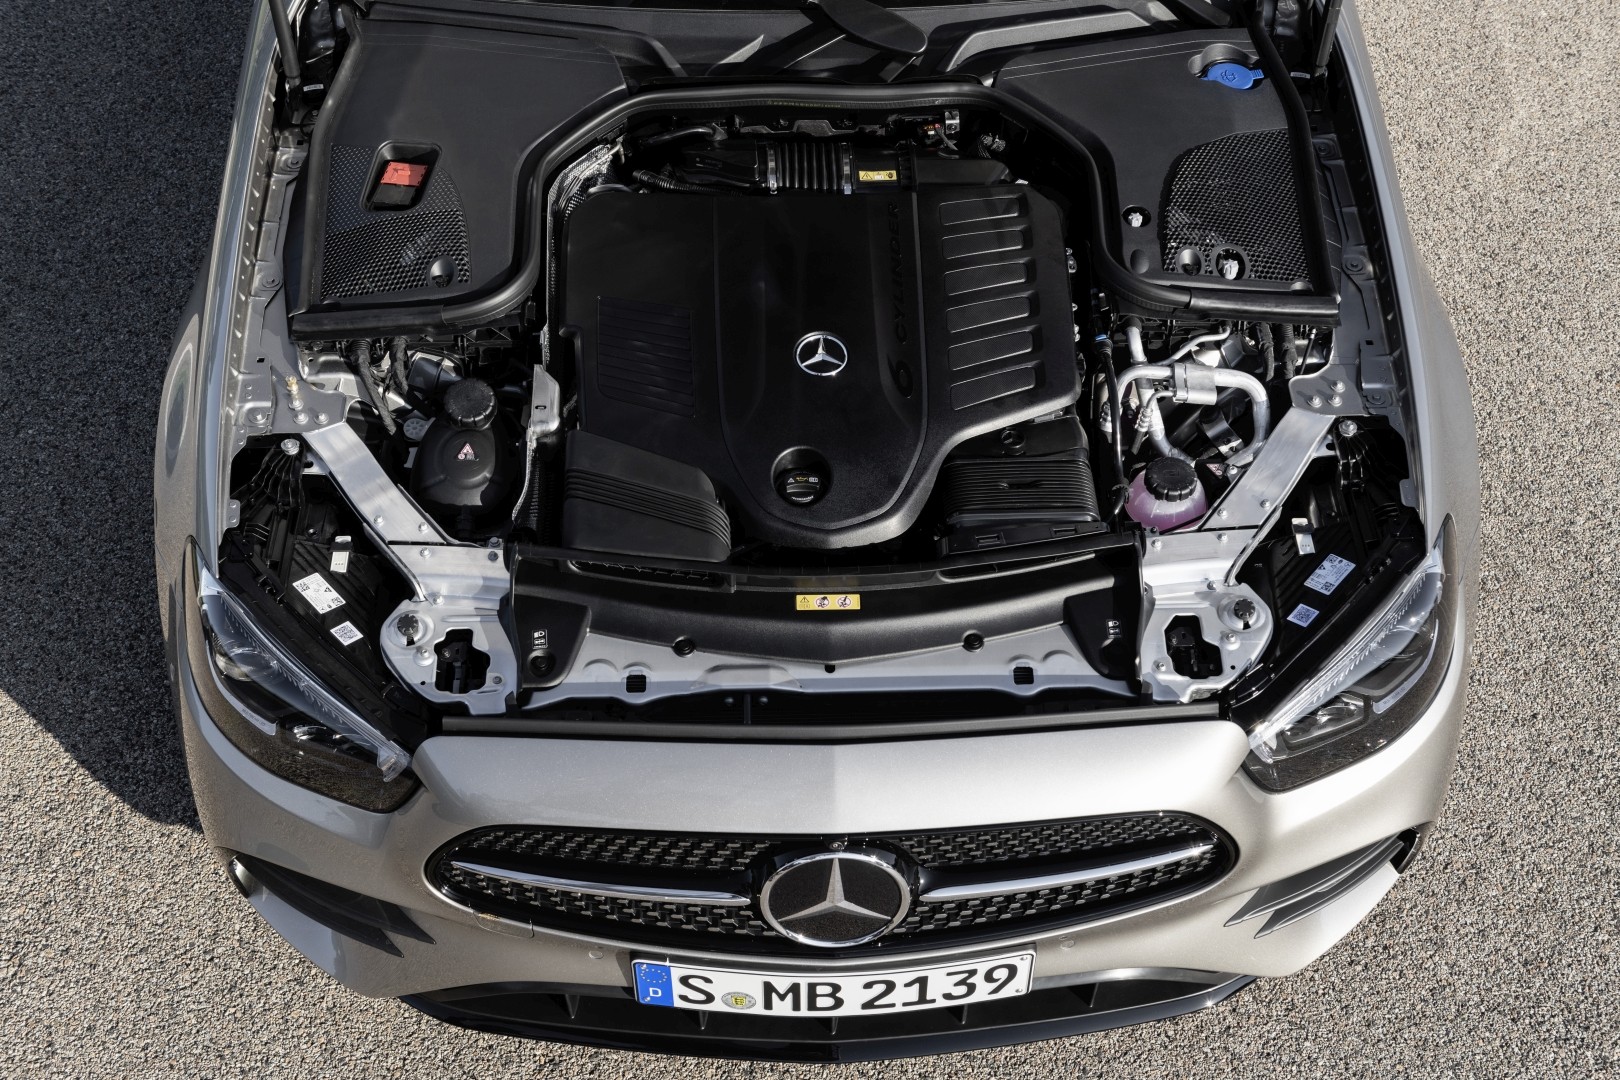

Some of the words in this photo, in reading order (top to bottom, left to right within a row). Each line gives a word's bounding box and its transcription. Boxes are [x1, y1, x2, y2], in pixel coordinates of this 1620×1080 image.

[888, 201, 908, 344] CYLINDER
[886, 353, 913, 399] 6
[649, 987, 662, 998] D
[678, 974, 716, 1005] S
[763, 980, 845, 1012] MB
[861, 963, 1018, 1010] 2139
